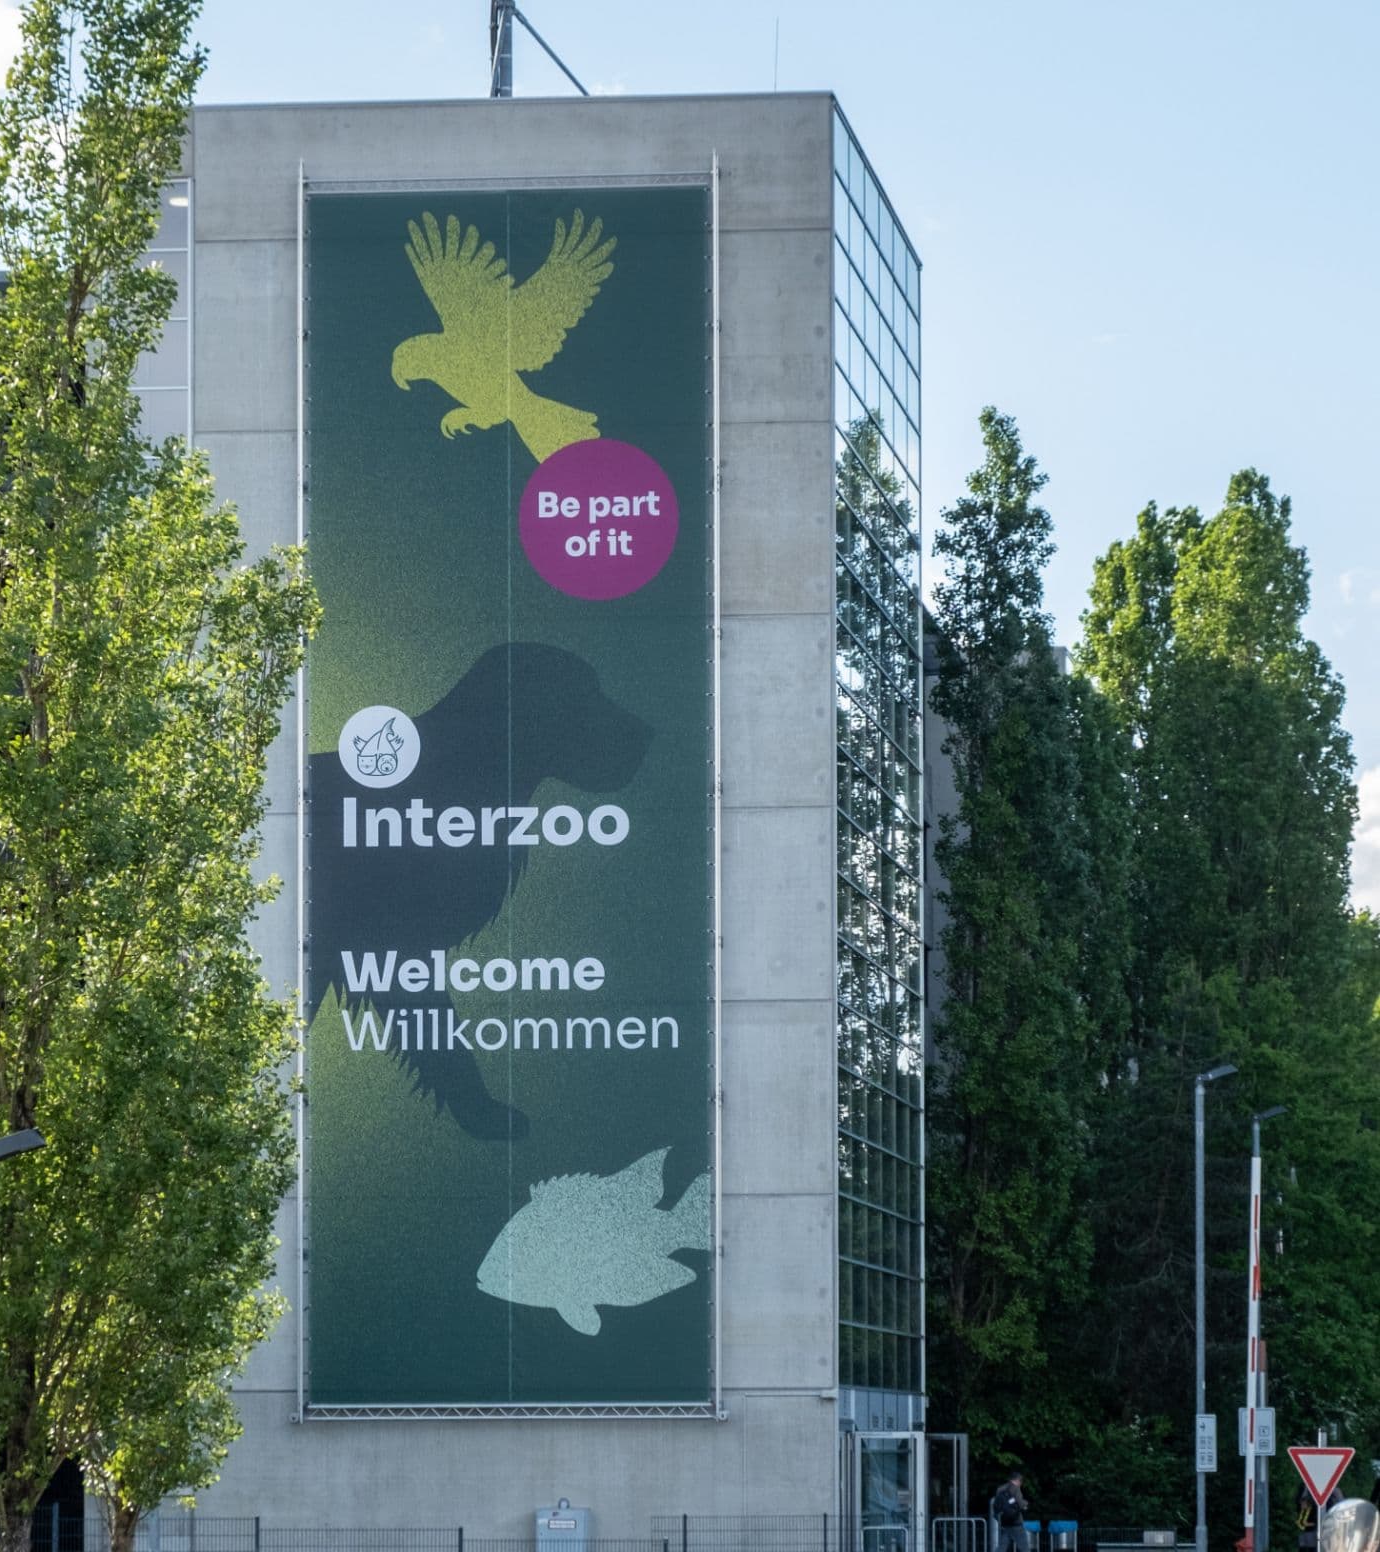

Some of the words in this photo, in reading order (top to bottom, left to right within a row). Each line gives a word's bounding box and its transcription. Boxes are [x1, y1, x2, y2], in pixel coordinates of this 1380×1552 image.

[538, 491, 581, 518] Be
[589, 491, 660, 524] part
[565, 529, 601, 557] of
[607, 528, 633, 556] it
[343, 797, 630, 847] Interzoo
[341, 950, 605, 992] Welcome
[342, 1009, 679, 1051] Willkommen
